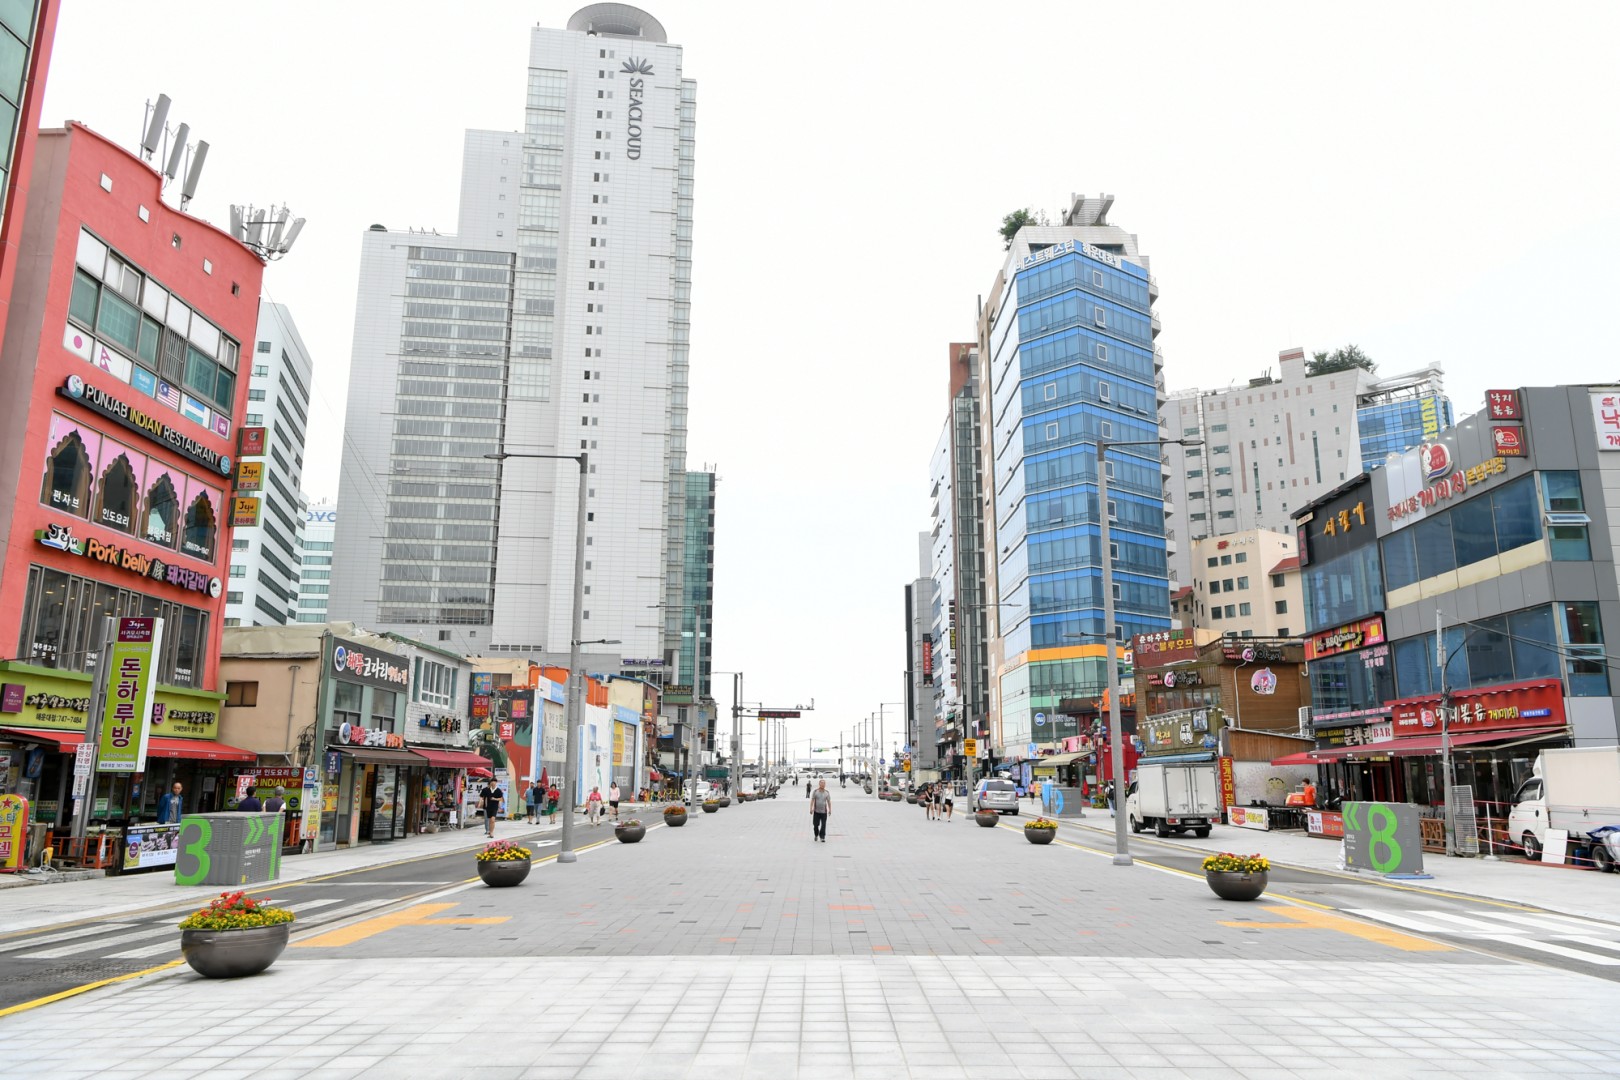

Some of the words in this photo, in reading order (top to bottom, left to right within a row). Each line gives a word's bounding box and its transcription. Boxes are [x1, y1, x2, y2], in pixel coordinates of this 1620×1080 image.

[626, 77, 644, 161] SEACLOUD
[85, 385, 128, 418] PUNJAB
[129, 407, 161, 435] INDIAN
[163, 427, 220, 466] RESTAURANT
[1491, 392, 1512, 404] 낙지
[102, 507, 130, 527] 인도요리
[88, 537, 118, 565] Pork
[121, 549, 151, 577] belly
[166, 564, 209, 594] 돼지갈비
[110, 657, 142, 749] 돈하루방
[1373, 726, 1392, 738] BAR
[259, 778, 287, 787] INDIAN
[175, 815, 213, 886] 3
[1367, 803, 1403, 873] 8
